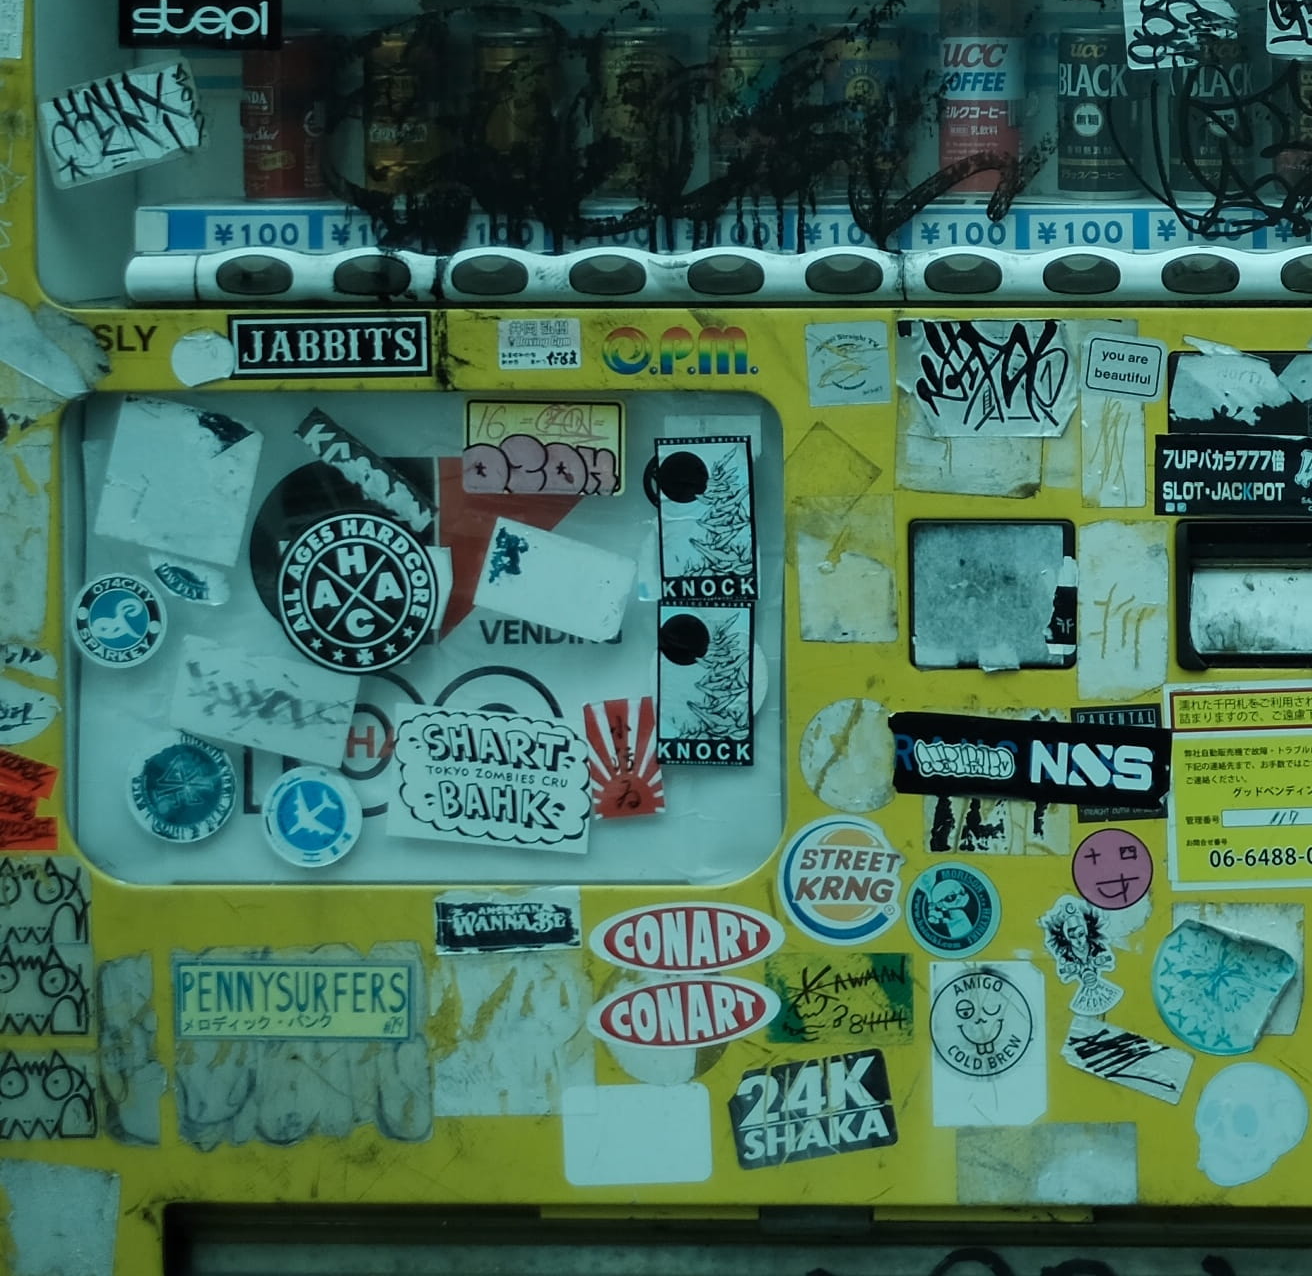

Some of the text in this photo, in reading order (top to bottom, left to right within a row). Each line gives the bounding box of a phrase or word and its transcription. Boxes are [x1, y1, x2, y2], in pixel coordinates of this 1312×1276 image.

[1058, 63, 1127, 98] BLACK
[215, 223, 299, 247] ¥100
[243, 327, 417, 363] JABBITS
[1101, 349, 1149, 364] you are
[1094, 367, 1152, 385] beautiful
[284, 519, 428, 633] ALL AGES HARDCORE
[662, 577, 756, 596] KNOCK
[80, 627, 151, 663] SPARKEY
[421, 723, 572, 772] SHART
[657, 742, 751, 761] KNOCK
[425, 764, 570, 788] TOKYO ZOMBIES CRU
[438, 780, 560, 831] BAHK
[1185, 815, 1220, 826] 管理番号
[800, 848, 901, 872] STREET
[795, 875, 896, 904] KRNG
[613, 909, 763, 970] CONART
[181, 970, 408, 1014] PENNYSURFERS
[952, 976, 1004, 997] AMIGO
[610, 983, 757, 1043] CONART
[946, 1033, 1023, 1071] COLD BREW
[736, 1054, 881, 1128] 24K
[743, 1107, 891, 1161] SHAKA
